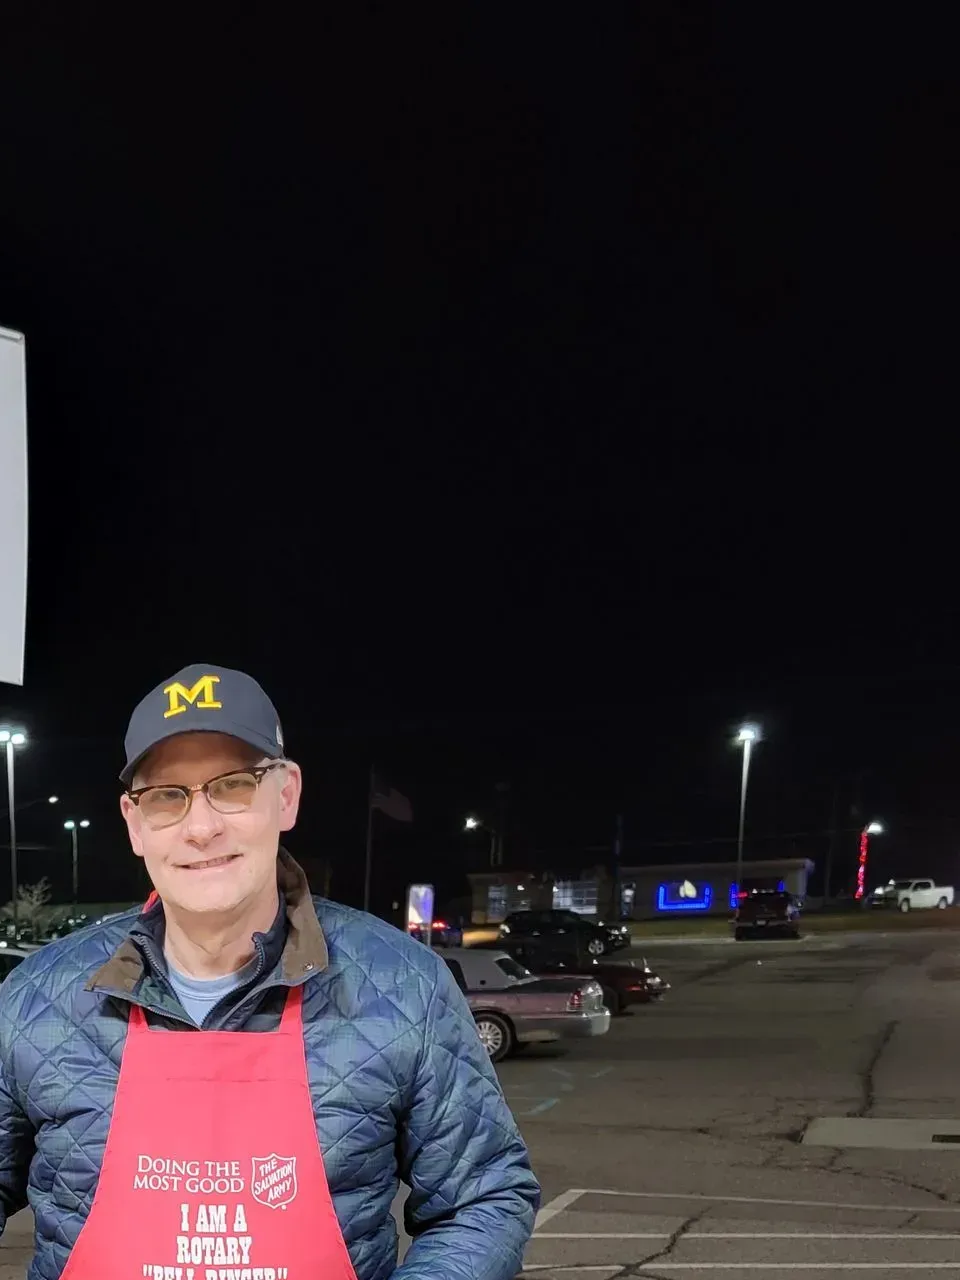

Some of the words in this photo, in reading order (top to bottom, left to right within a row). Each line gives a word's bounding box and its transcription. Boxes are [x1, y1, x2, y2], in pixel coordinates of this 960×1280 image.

[163, 675, 222, 718] M
[138, 1155, 200, 1176] DOING
[204, 1161, 240, 1177] THE
[254, 1161, 294, 1196] SALVATION
[259, 1157, 278, 1177] THE
[133, 1175, 182, 1192] MOST
[185, 1177, 244, 1194] GOOD
[267, 1177, 292, 1202] ARMY
[181, 1203, 189, 1232] I
[196, 1204, 227, 1233] AM
[233, 1204, 248, 1232] A
[176, 1235, 252, 1265] ROTARY
